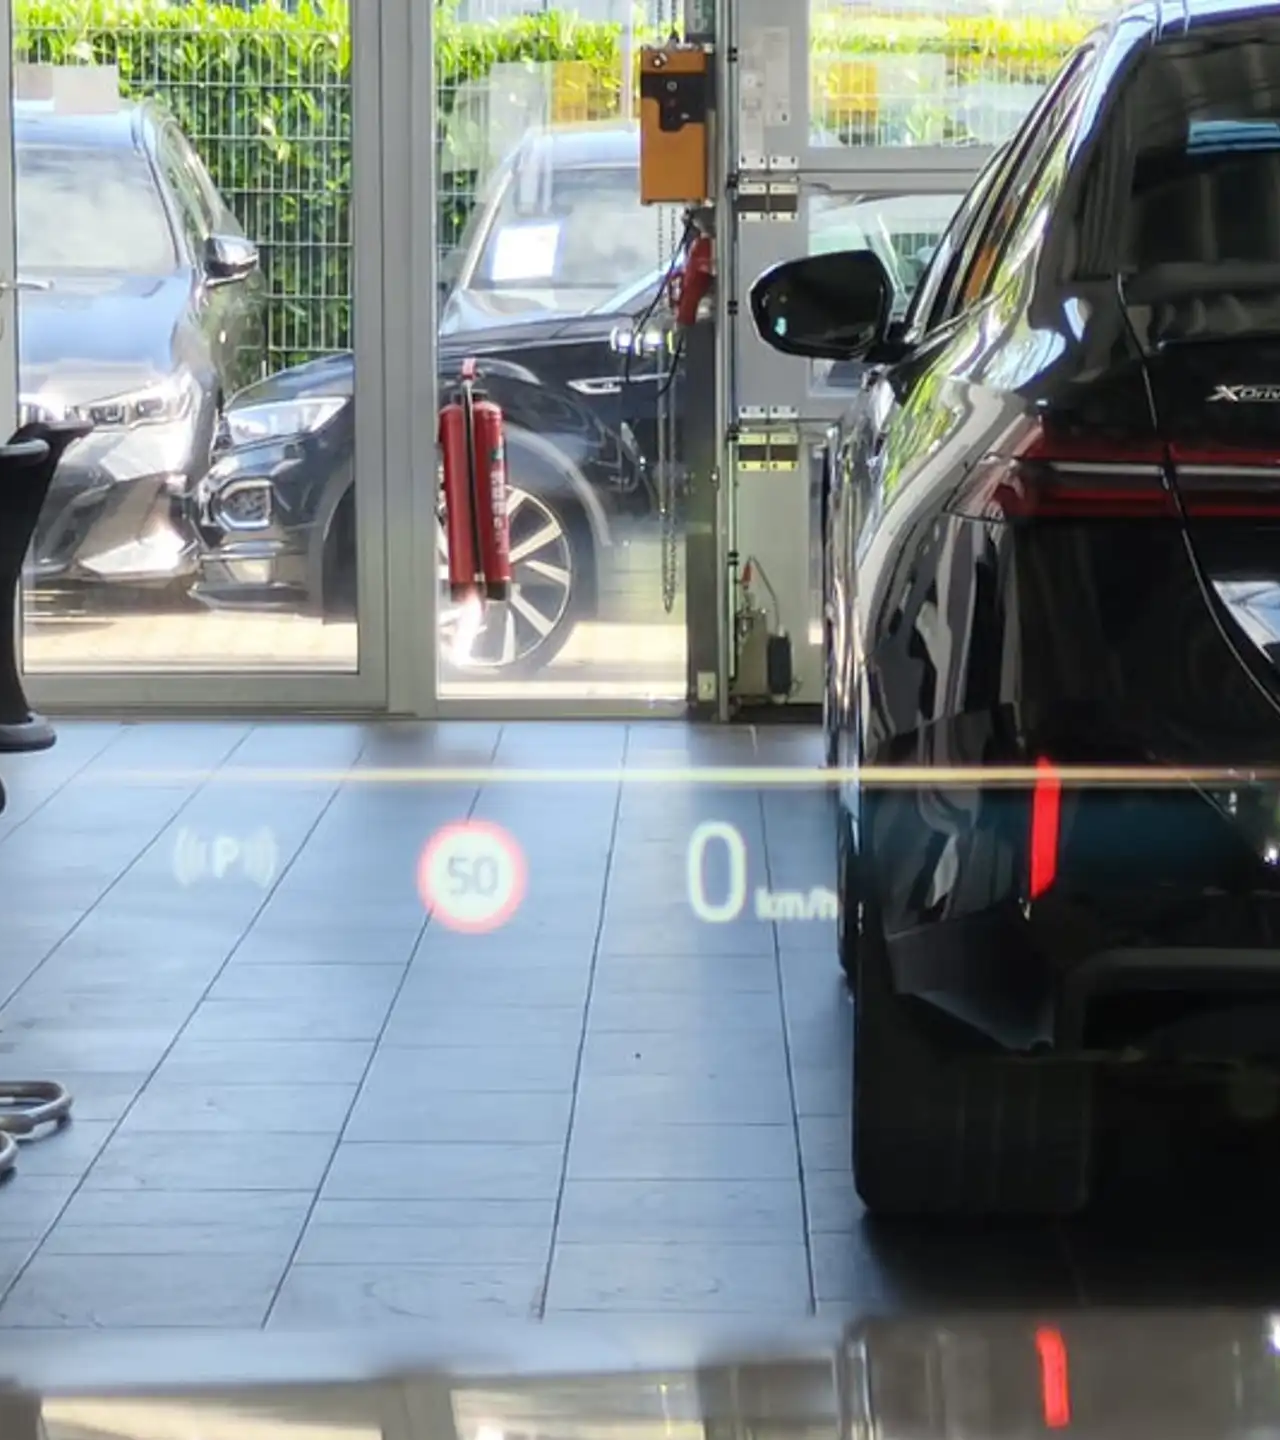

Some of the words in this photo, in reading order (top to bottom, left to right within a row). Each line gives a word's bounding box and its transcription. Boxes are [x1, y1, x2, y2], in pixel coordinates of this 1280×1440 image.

[447, 855, 499, 897] 50
[688, 819, 747, 923] 0
[754, 886, 839, 921] km/h
